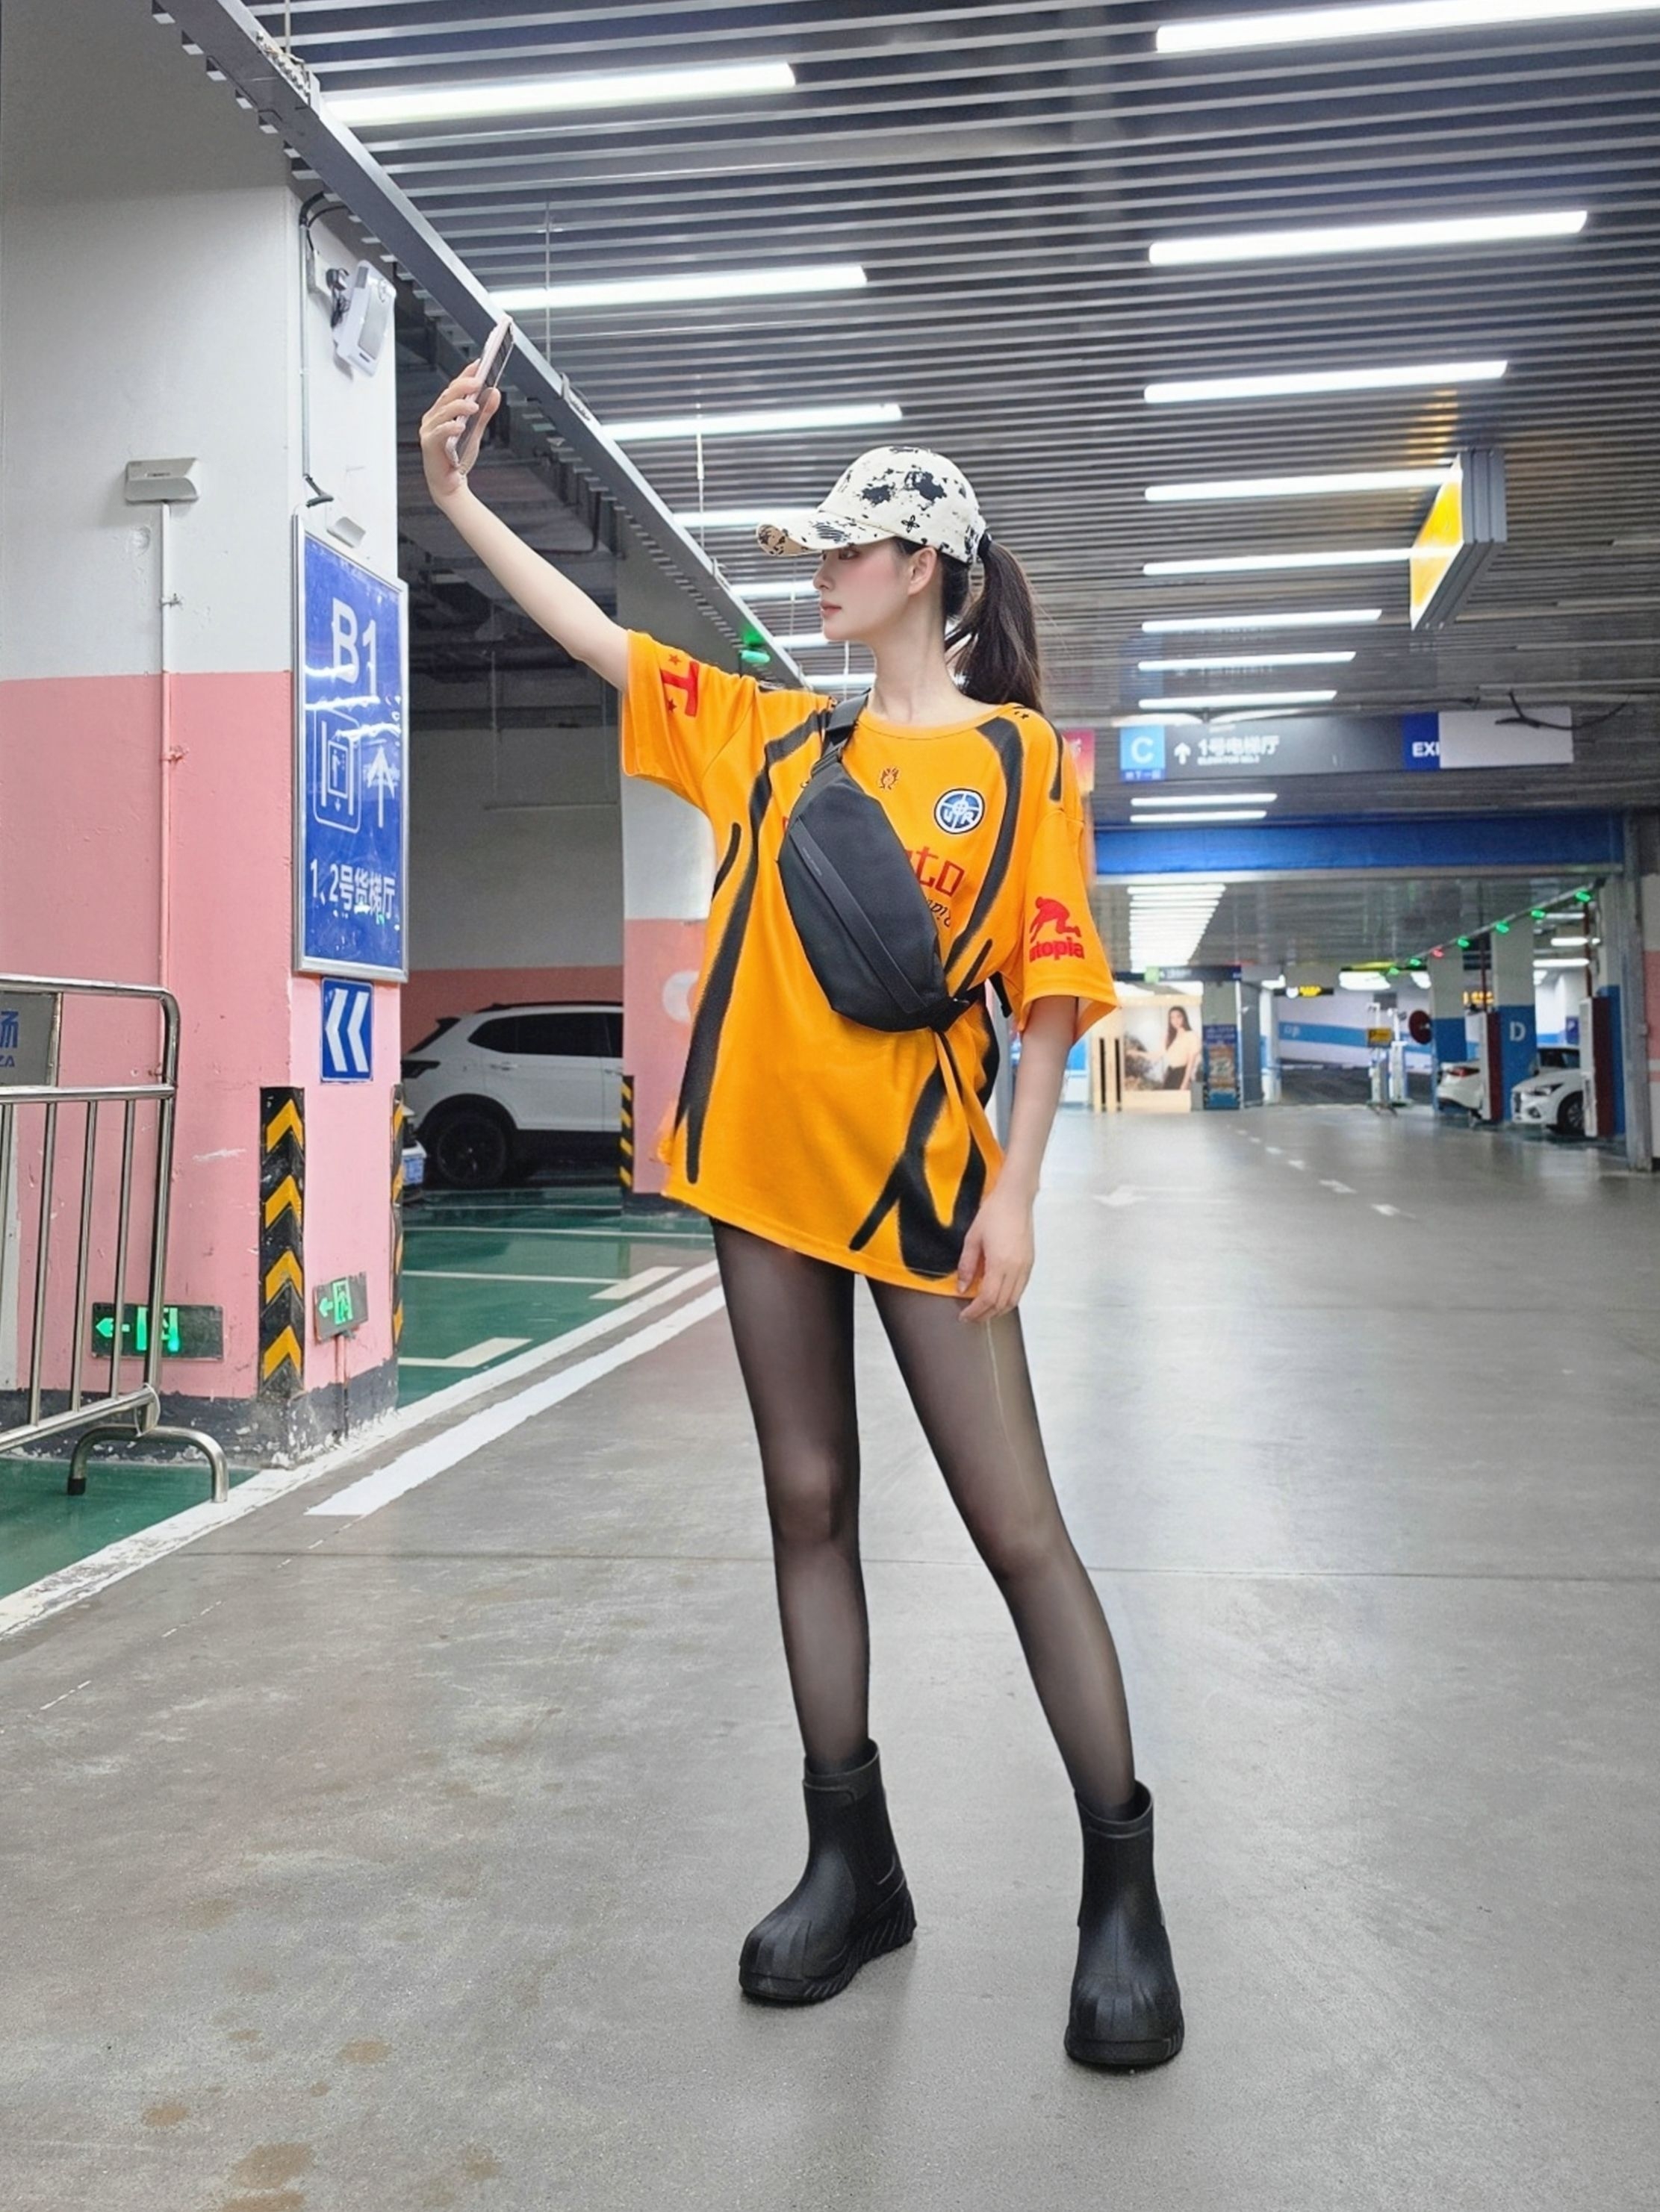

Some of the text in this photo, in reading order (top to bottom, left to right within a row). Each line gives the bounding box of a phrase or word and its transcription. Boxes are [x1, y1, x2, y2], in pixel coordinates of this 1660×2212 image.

[332, 597, 376, 697] B1
[1131, 736, 1154, 764] C
[1510, 1022, 1526, 1041] D
